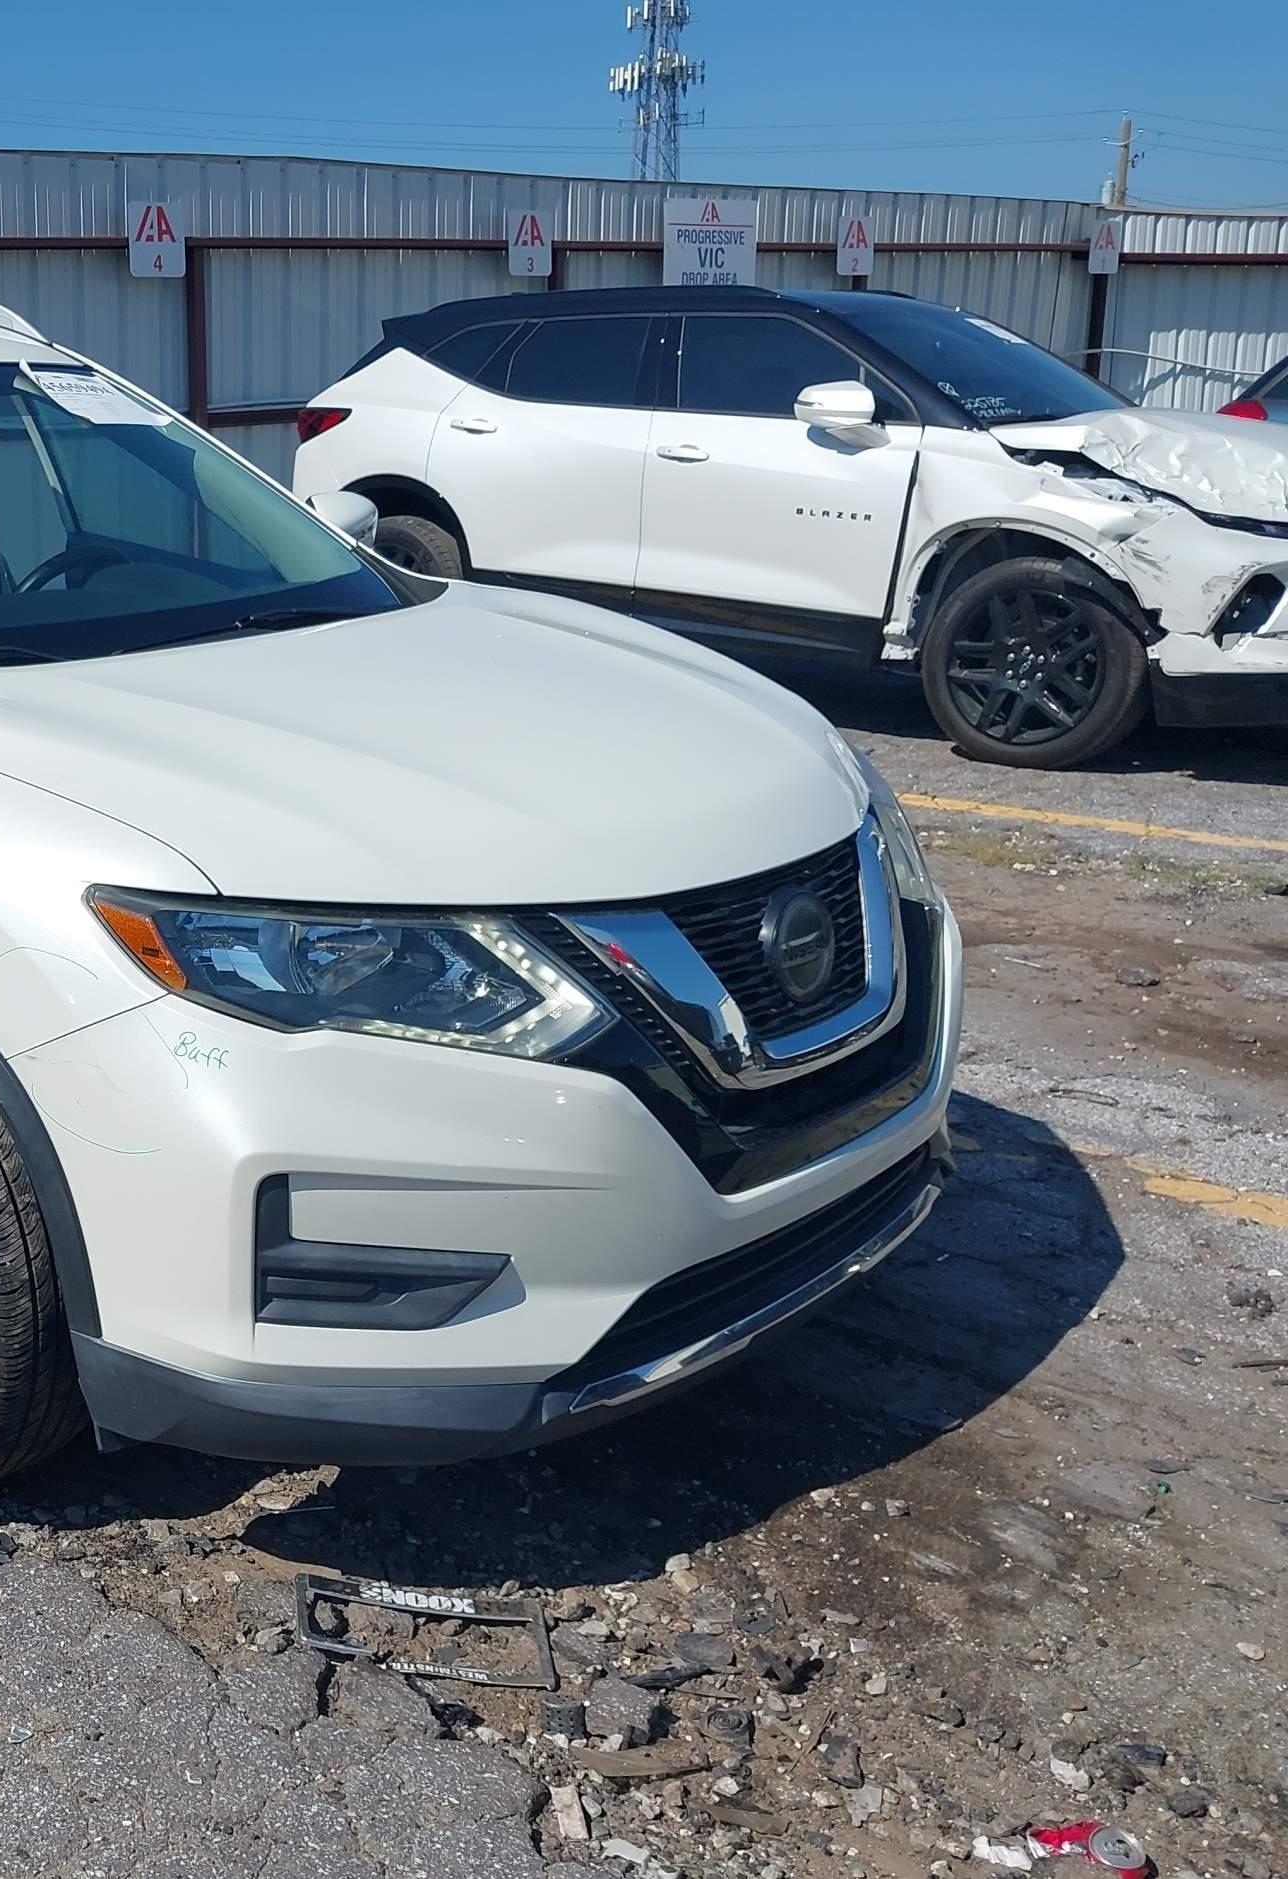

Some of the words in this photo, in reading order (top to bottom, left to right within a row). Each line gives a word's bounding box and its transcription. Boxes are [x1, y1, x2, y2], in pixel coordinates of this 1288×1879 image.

[676, 228, 745, 246] PROGRESSIVE
[153, 254, 163, 273] 4
[527, 256, 534, 273] 3
[697, 246, 725, 269] VIC
[851, 258, 859, 272] 2
[681, 271, 709, 286] DROP
[712, 272, 738, 286] AREA
[795, 507, 872, 522] BLAZER
[173, 1031, 230, 1070] Buff
[358, 1580, 475, 1614] KOONS
